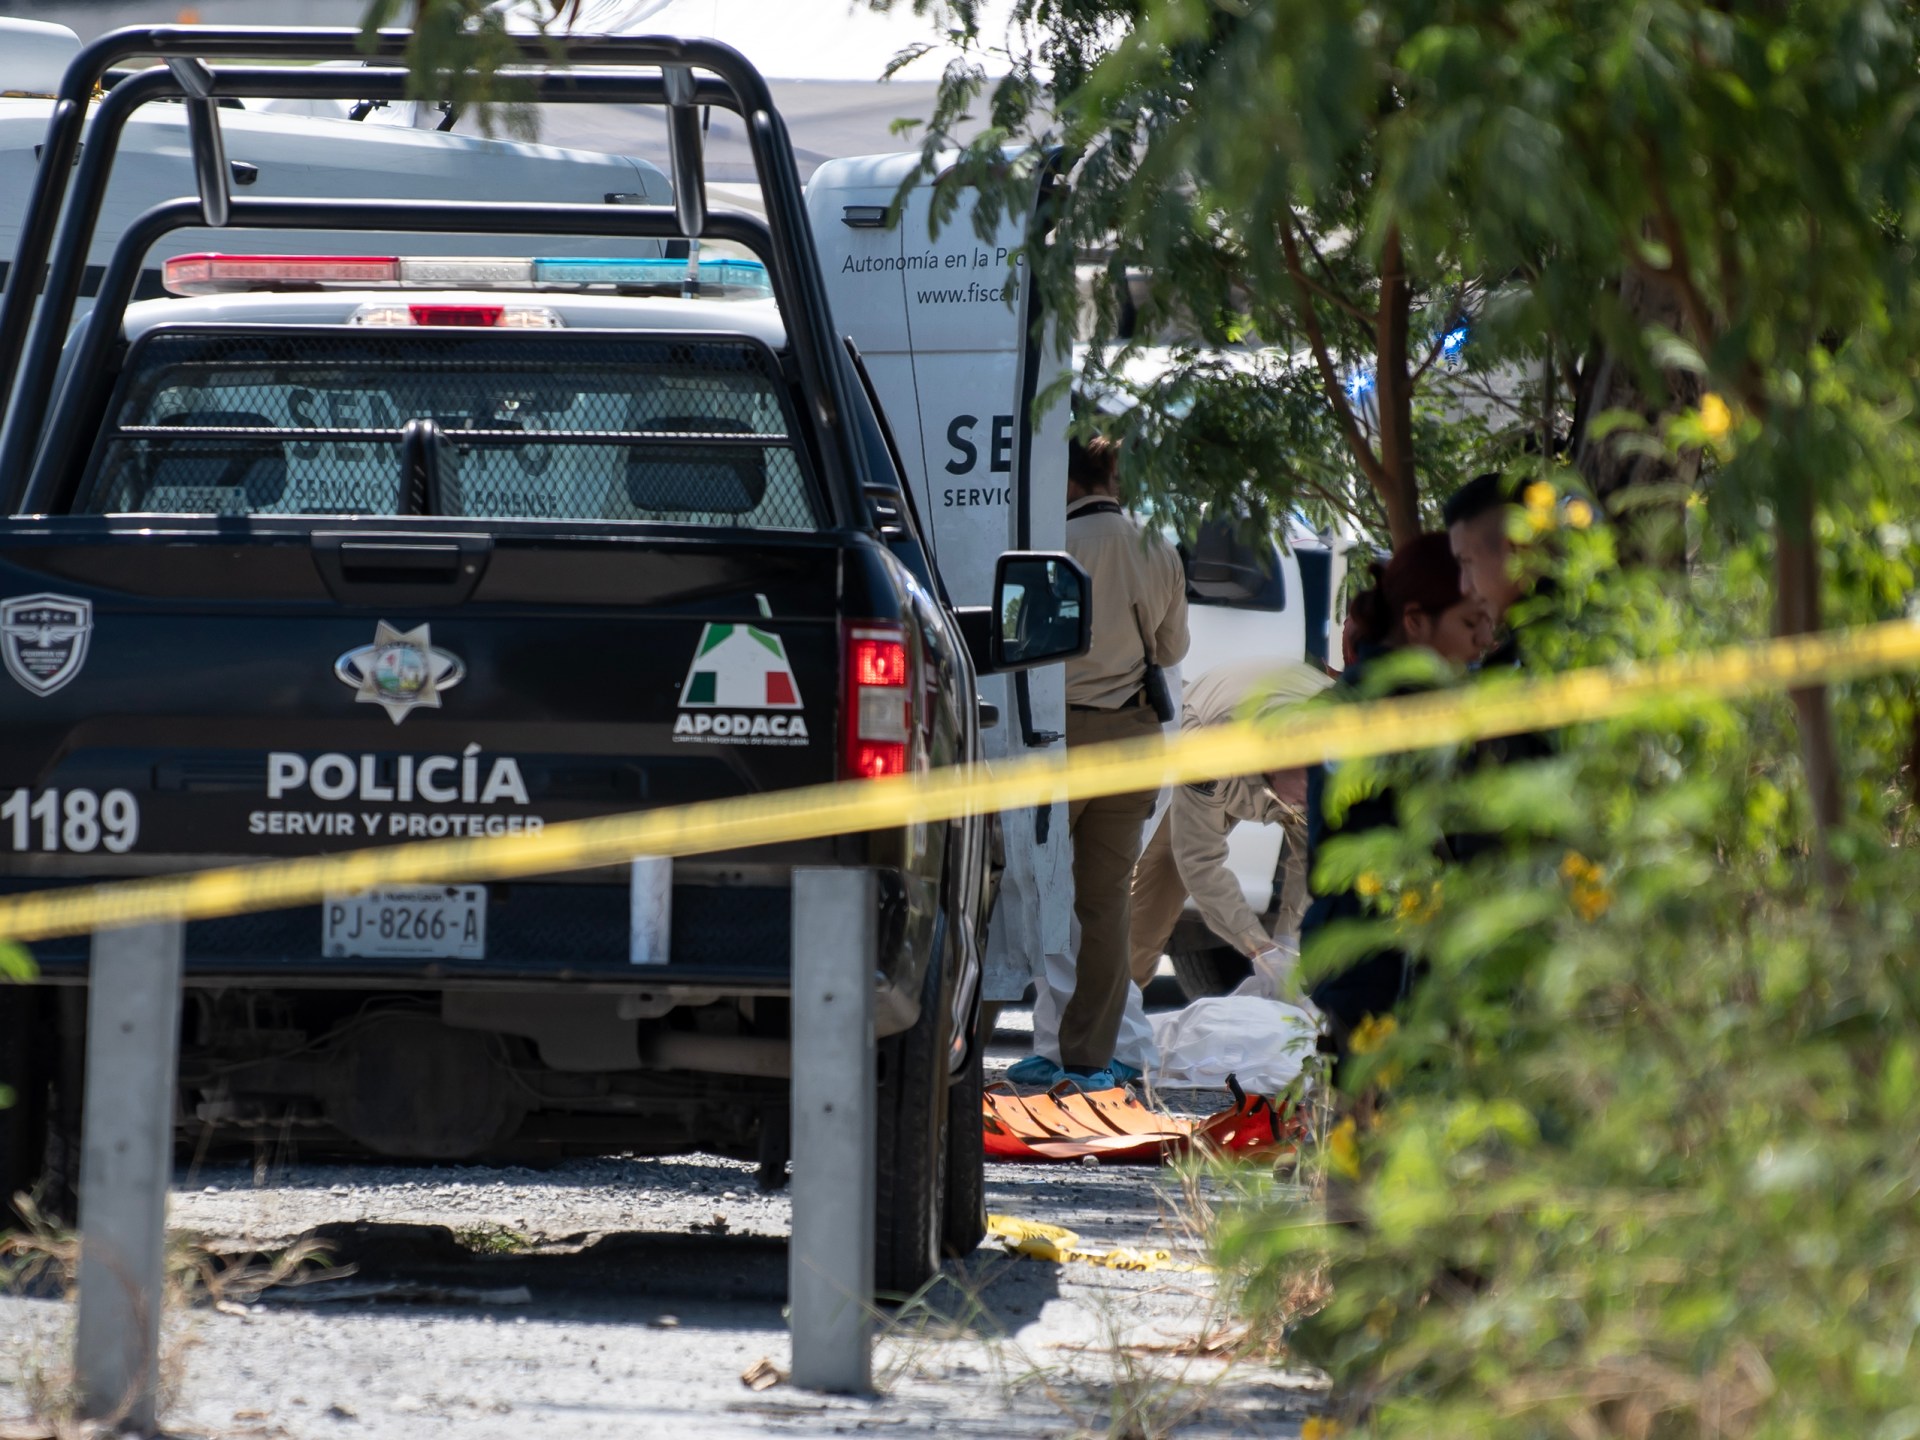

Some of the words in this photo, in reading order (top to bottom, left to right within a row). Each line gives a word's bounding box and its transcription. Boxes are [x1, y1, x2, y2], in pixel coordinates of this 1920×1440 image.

[841, 249, 939, 273] Autonomía
[944, 254, 967, 268] en
[973, 247, 989, 268] la
[672, 713, 809, 736] APODACA
[266, 741, 530, 805] POLICÍA
[0, 787, 140, 854] 1189
[248, 811, 355, 836] SERVIR
[361, 813, 383, 836] Y
[388, 813, 546, 839] PROTEGER
[328, 905, 479, 942] PJ-8266-A
